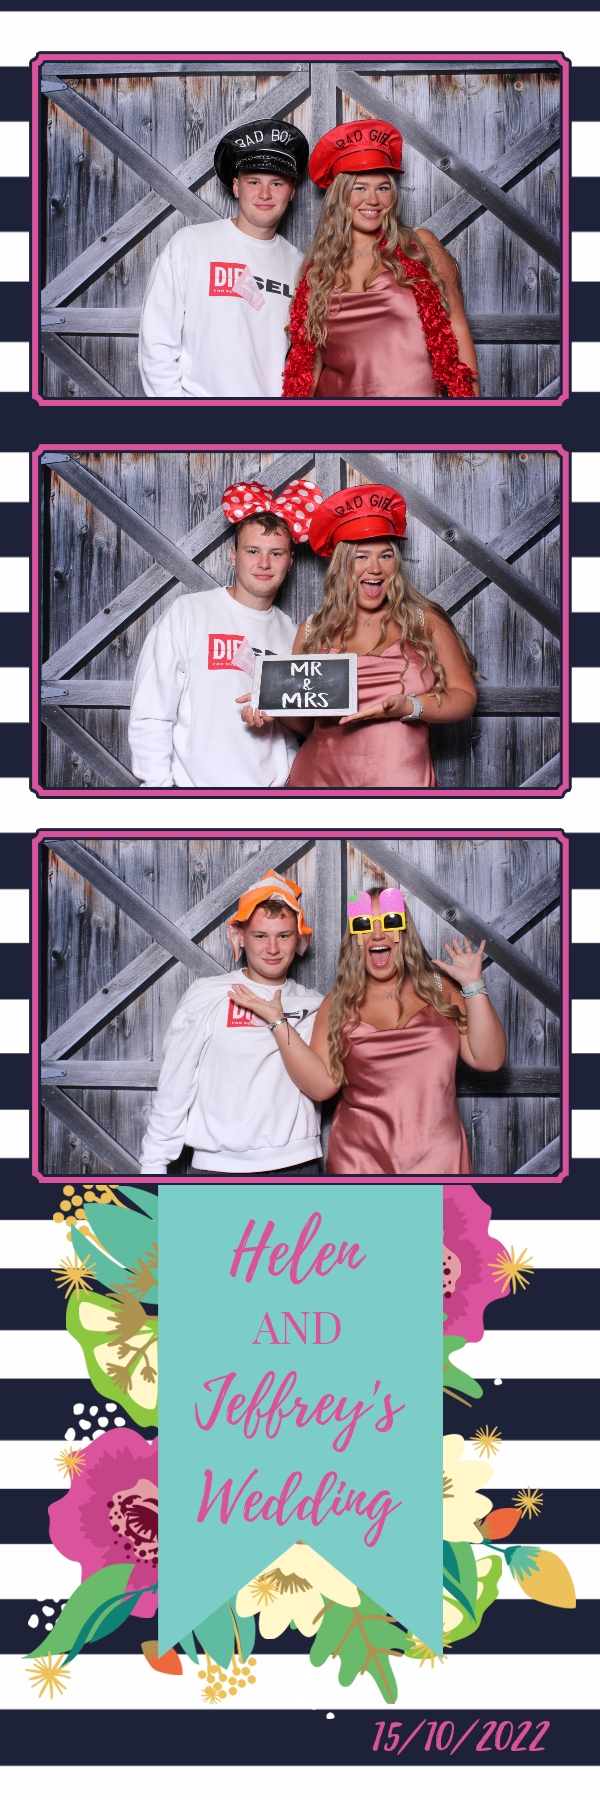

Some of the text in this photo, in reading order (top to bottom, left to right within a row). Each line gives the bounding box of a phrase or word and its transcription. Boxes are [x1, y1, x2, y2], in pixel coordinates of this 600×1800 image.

[235, 129, 295, 148] BAD BOY
[335, 129, 363, 148] BAD
[335, 495, 363, 515] BAD
[290, 661, 323, 677] MR
[302, 677, 315, 691] &
[281, 691, 329, 709] MRS
